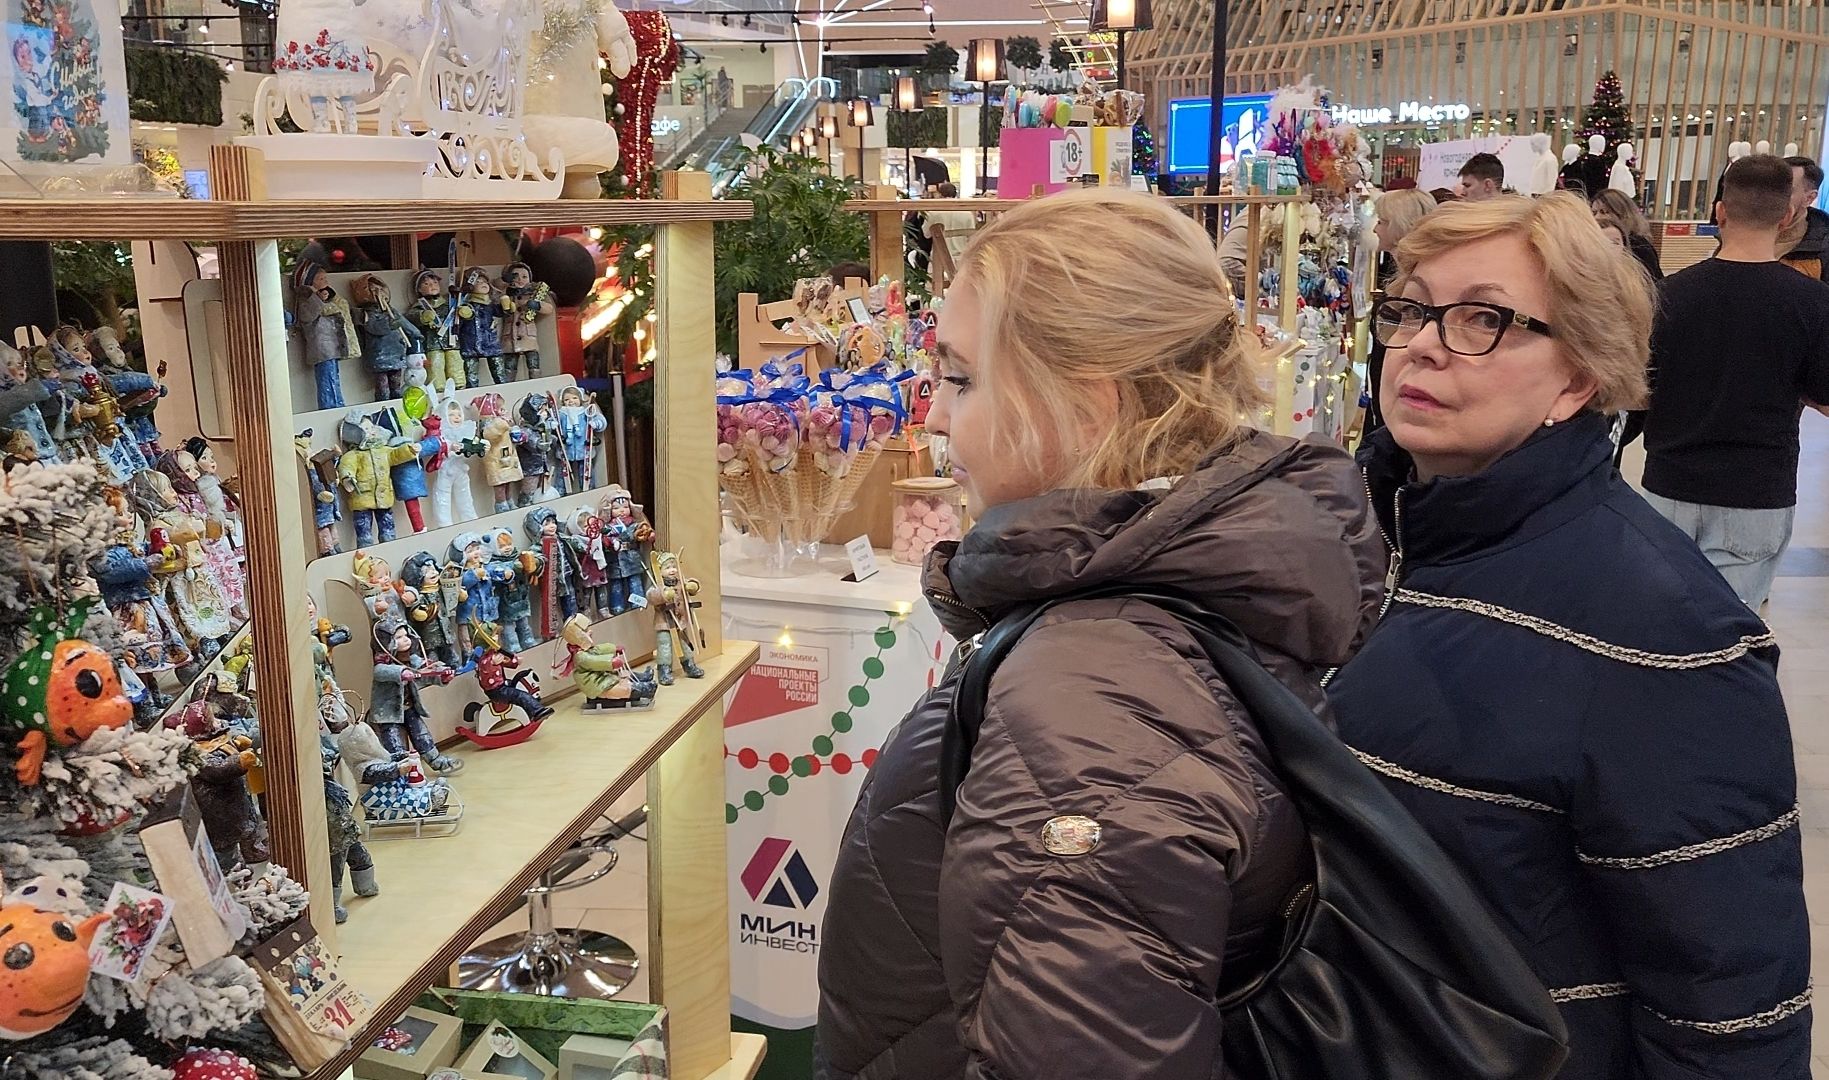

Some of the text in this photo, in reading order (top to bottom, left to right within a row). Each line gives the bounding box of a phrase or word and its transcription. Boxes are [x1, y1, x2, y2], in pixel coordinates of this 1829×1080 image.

[1331, 101, 1470, 124] Наше Место
[1065, 142, 1083, 162] 18+
[769, 651, 818, 662] ЭКОНОМИКА
[750, 665, 817, 682] НАЦИОНАЛЬНЫЕ
[778, 679, 817, 693] ПРОЕКТЫ
[785, 690, 817, 703] РОССИИ
[740, 913, 816, 940] МИН
[740, 932, 820, 954] ИНВЕСТ
[324, 998, 356, 1030] 31
